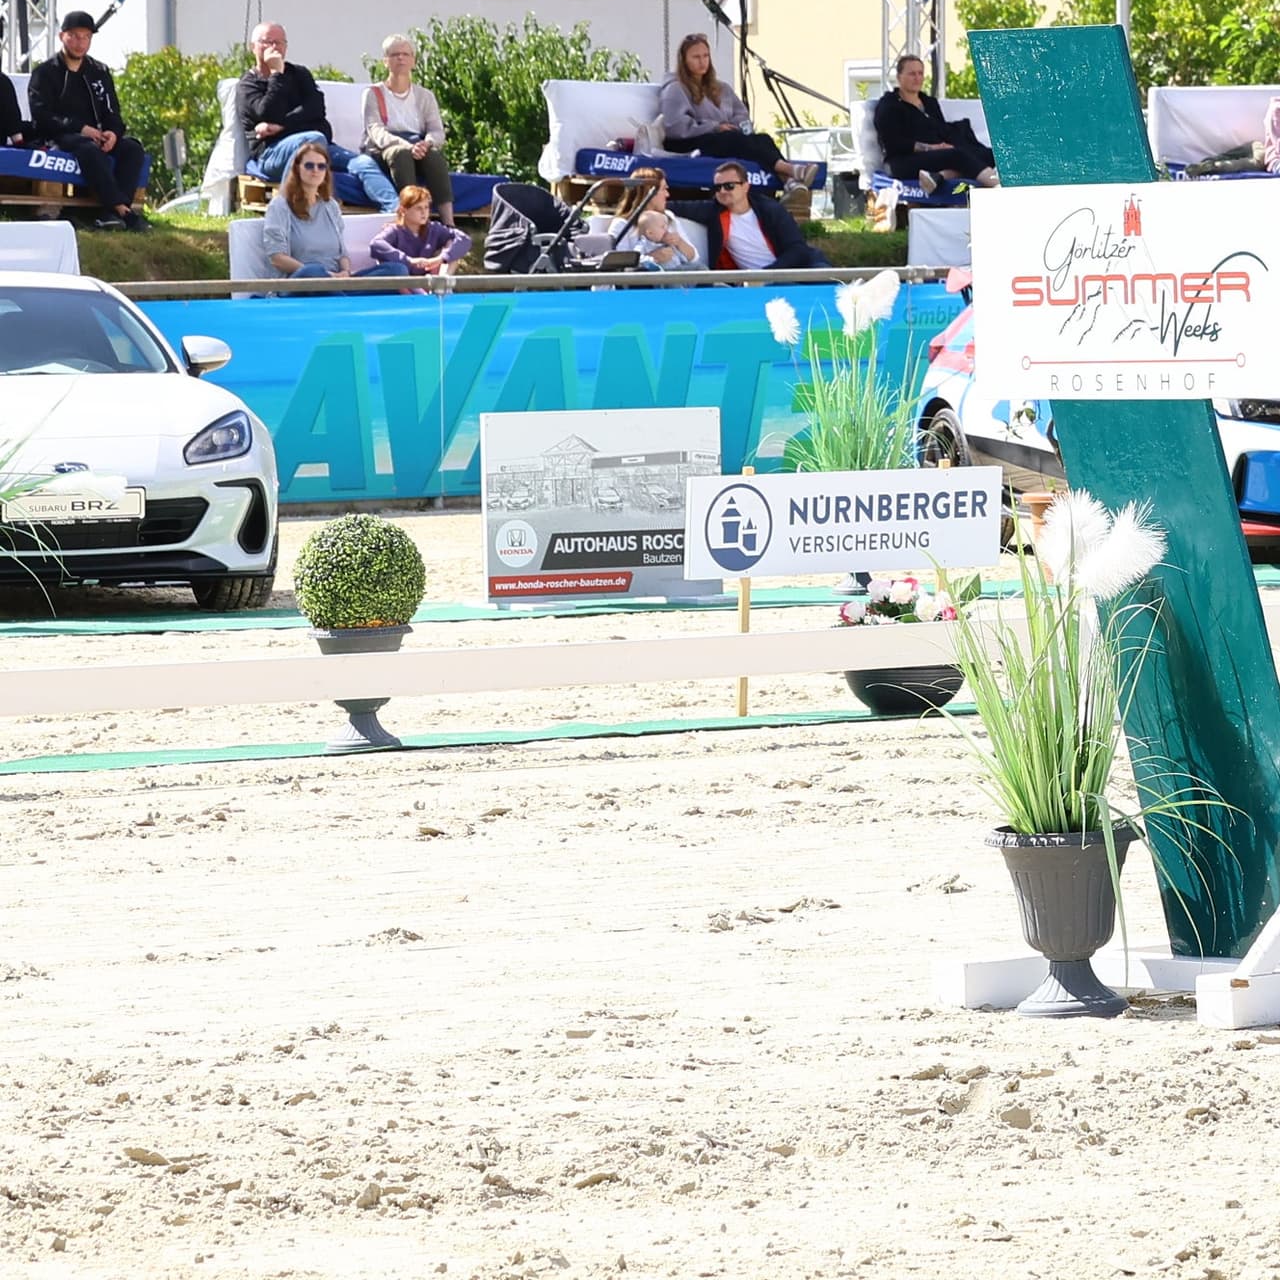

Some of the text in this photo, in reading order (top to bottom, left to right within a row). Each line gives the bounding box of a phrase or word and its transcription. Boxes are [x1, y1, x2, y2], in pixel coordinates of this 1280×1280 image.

[1011, 271, 1252, 307] SUMMER
[1155, 289, 1222, 357] Weeks
[1050, 372, 1217, 392] ROSENHOF
[28, 500, 120, 513] SUBARU BRZ
[789, 489, 989, 526] NÜRNBERGER
[499, 548, 534, 557] HONDA
[553, 534, 638, 555] AUTOHAUS
[789, 531, 931, 554] VERSICHERUNG
[642, 552, 683, 565] Bautzen
[494, 575, 627, 591] www.honda-roscher-bautzen.de
